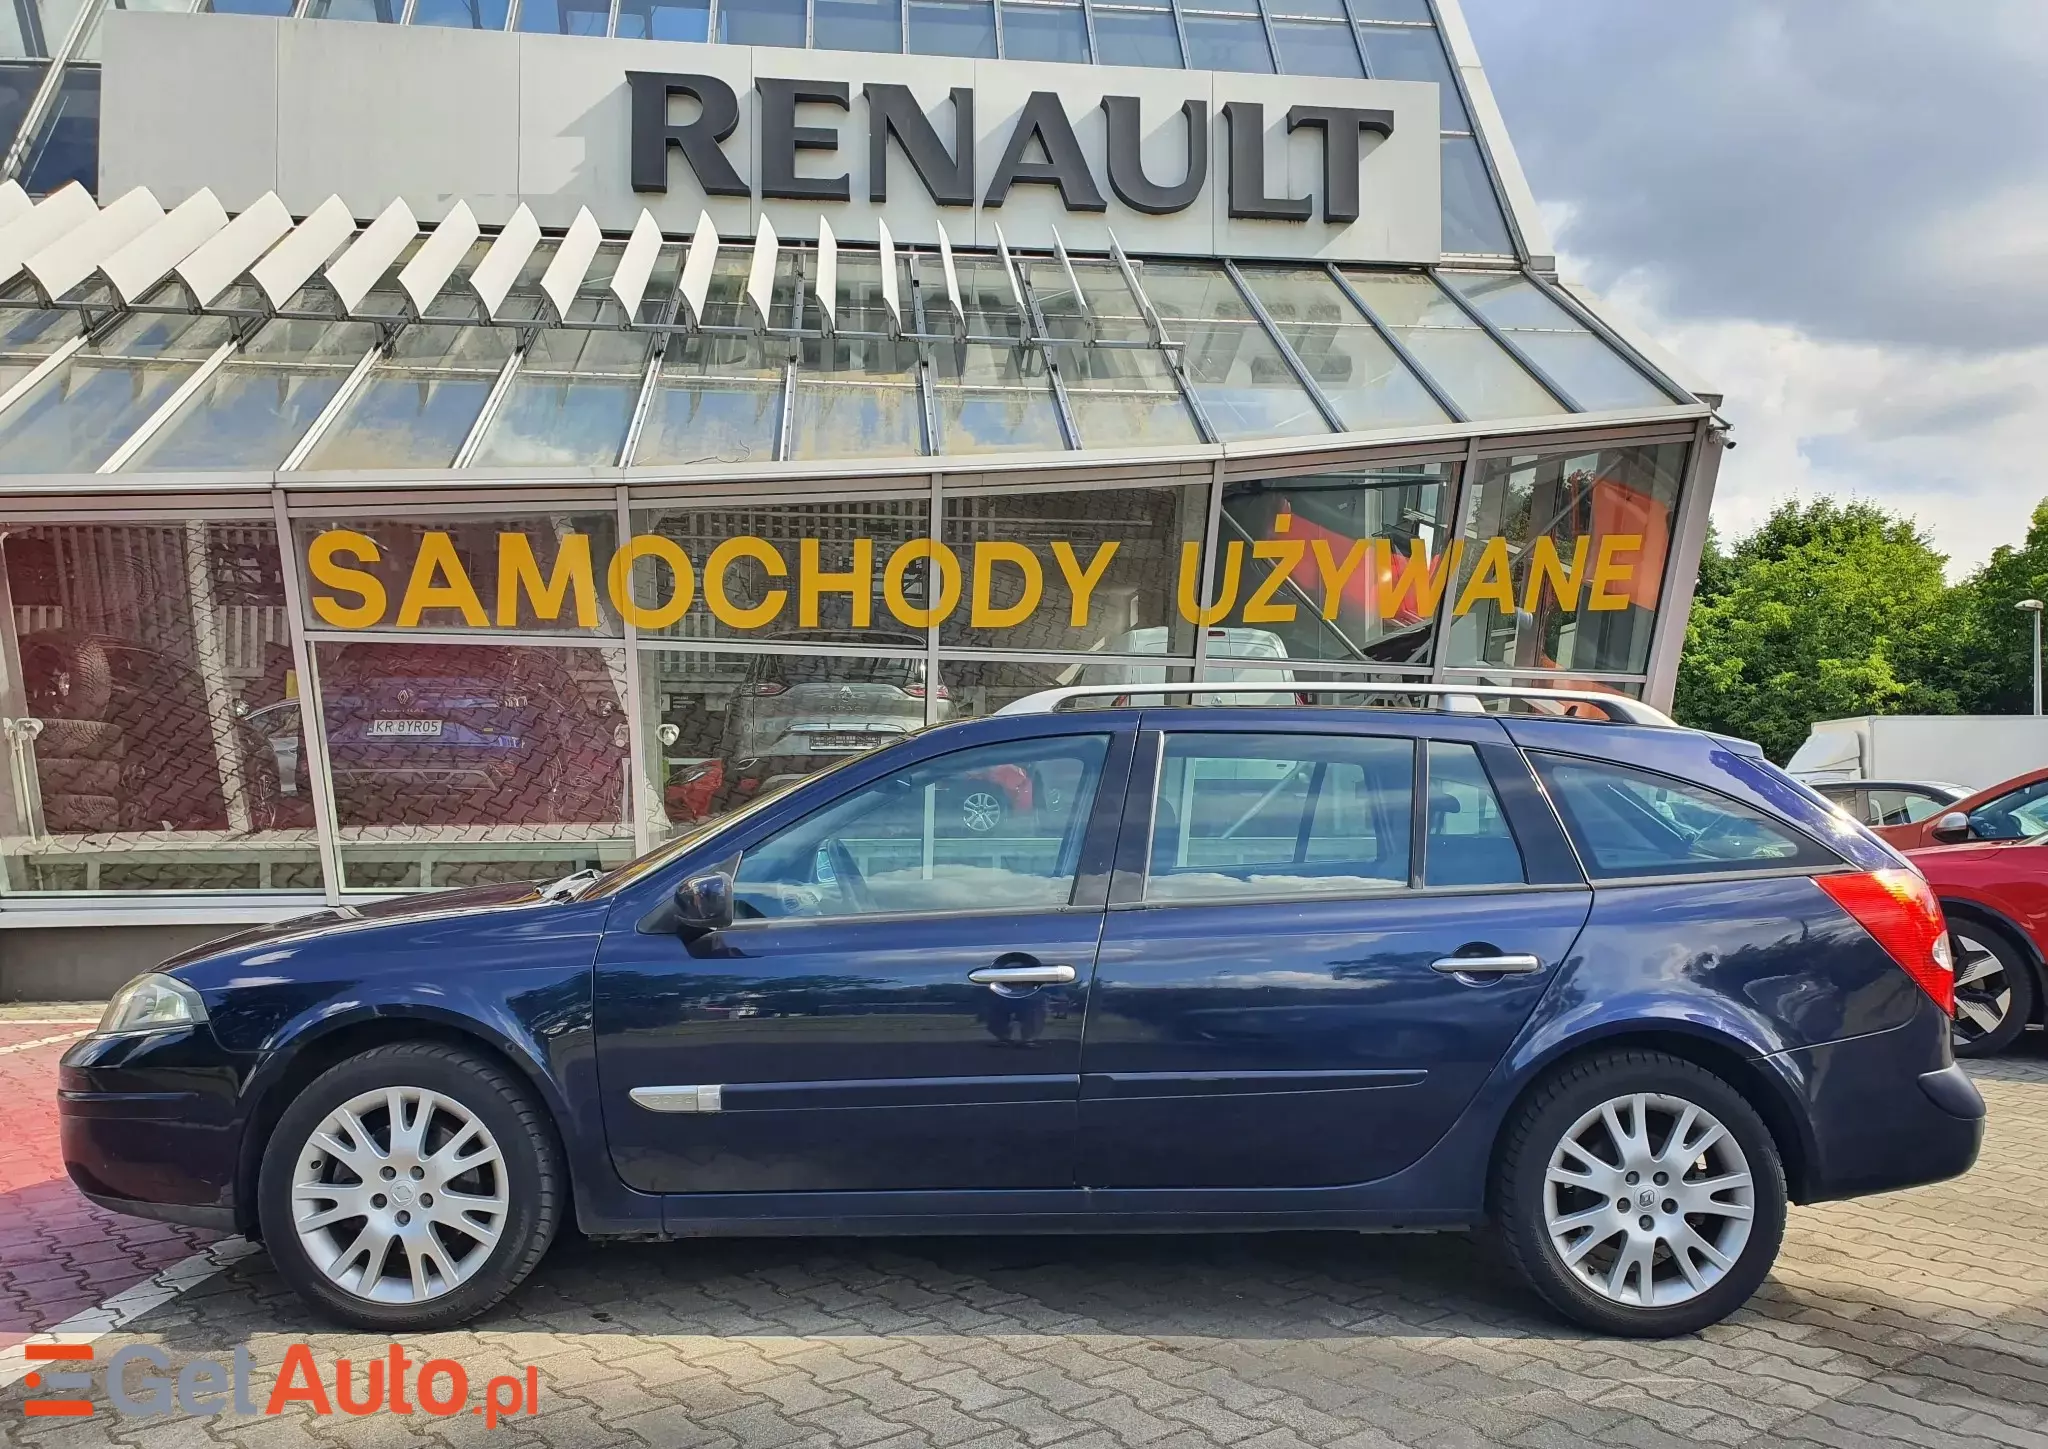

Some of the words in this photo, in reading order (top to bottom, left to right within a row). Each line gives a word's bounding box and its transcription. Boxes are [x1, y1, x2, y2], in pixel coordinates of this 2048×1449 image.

[625, 71, 1395, 225] RENAULT
[310, 530, 1118, 628] SAMOCHODY
[1179, 514, 1643, 627] UŻYWANE
[376, 720, 394, 733] KR
[397, 720, 439, 733] 8YR05
